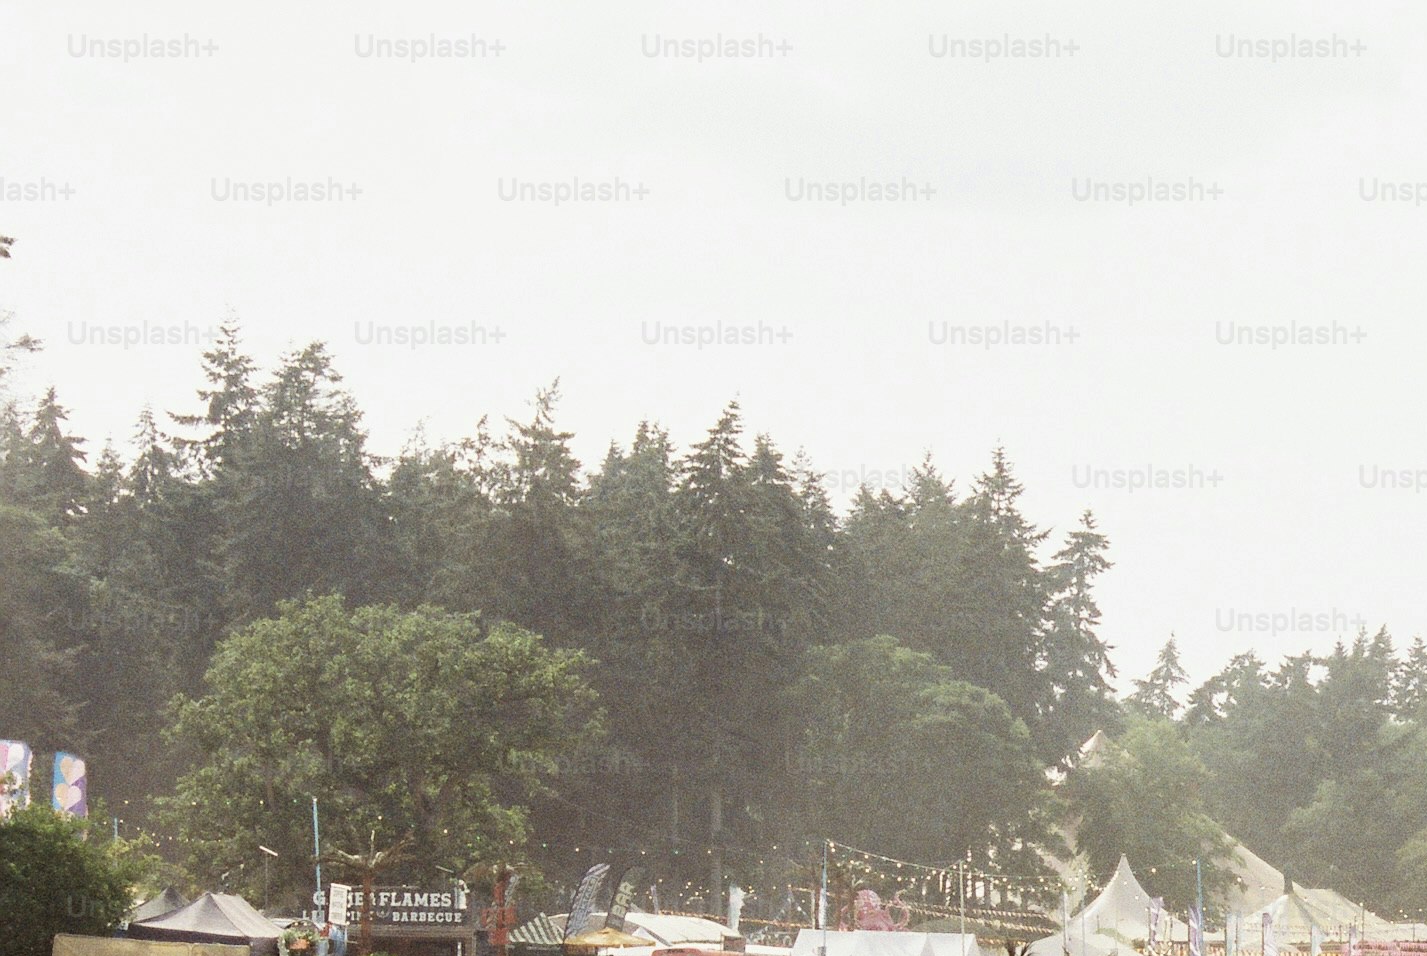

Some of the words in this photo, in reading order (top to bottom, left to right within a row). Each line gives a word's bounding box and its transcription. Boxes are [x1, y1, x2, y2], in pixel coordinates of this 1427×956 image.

[379, 891, 452, 908] FLAMES
[606, 881, 631, 918] BAR
[392, 911, 463, 923] BARBECUE
